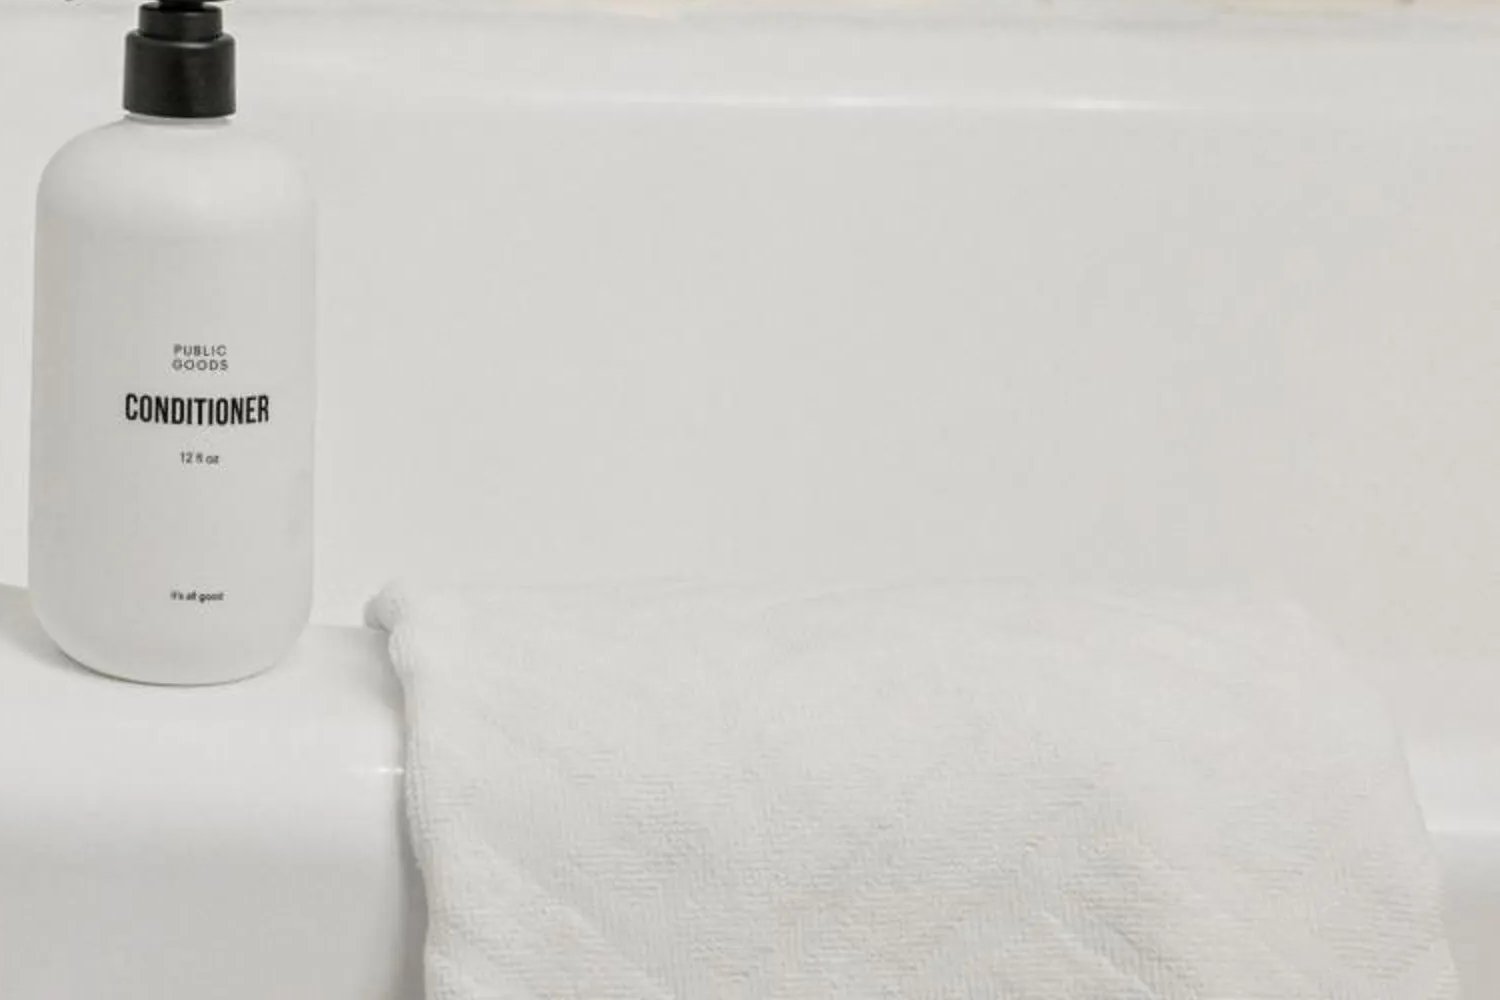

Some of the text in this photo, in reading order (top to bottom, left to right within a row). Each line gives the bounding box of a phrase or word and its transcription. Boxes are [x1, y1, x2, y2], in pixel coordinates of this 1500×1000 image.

[173, 343, 227, 357] PUBLIC
[171, 358, 229, 372] GOODS
[124, 391, 270, 427] CONDITIONER
[180, 451, 220, 465] 12 fl oz
[186, 591, 197, 602] all
[198, 591, 225, 604] good
